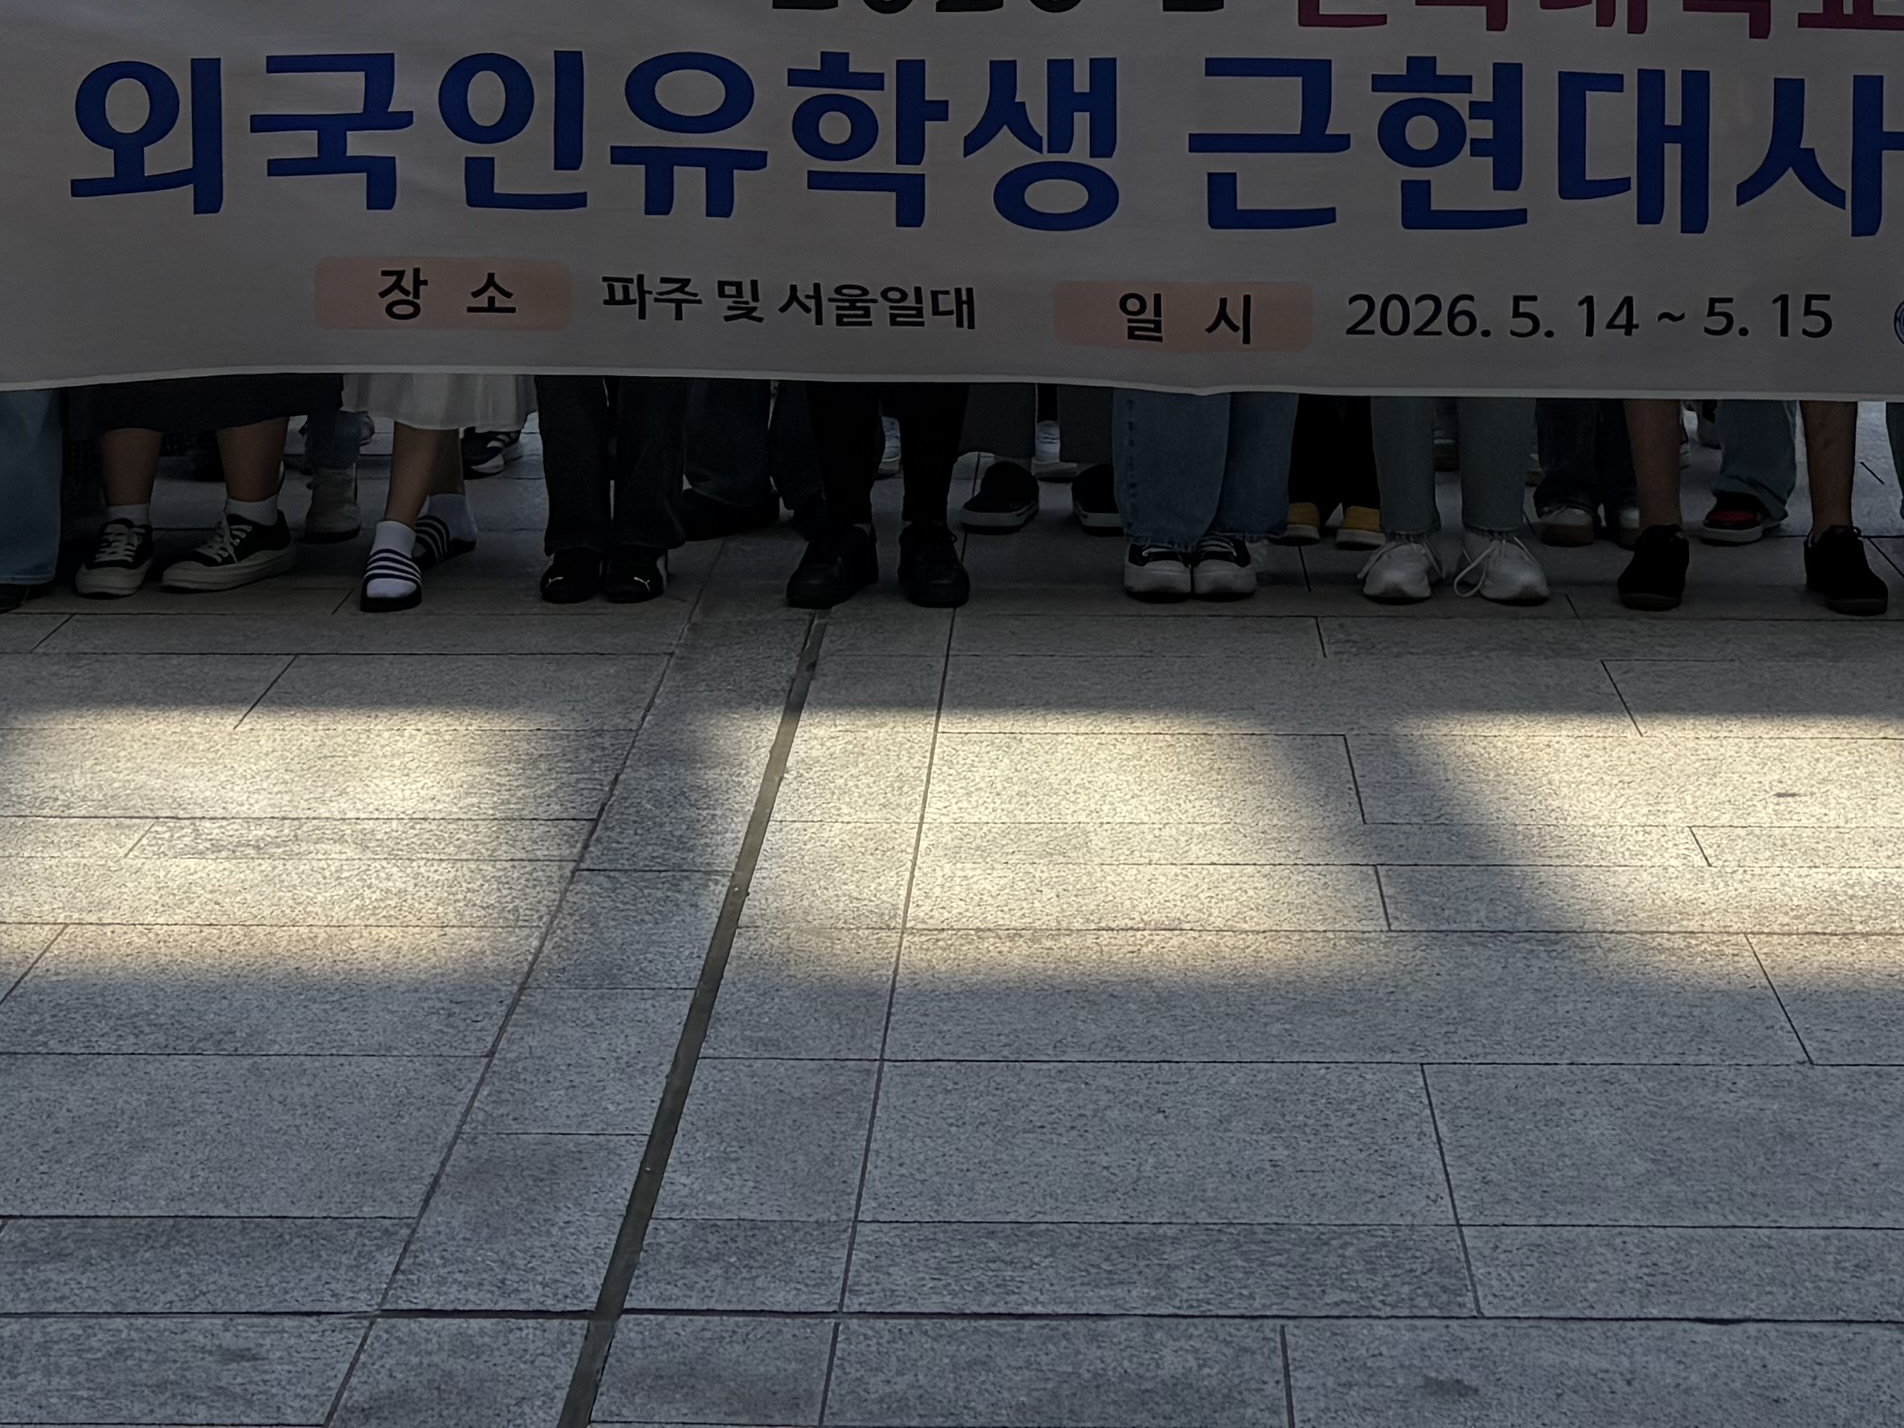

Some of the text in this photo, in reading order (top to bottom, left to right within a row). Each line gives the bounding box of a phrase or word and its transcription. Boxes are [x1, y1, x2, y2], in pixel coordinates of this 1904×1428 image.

[71, 50, 1119, 231] 외국인유학생
[602, 274, 702, 321] 파주
[717, 280, 764, 323] 및
[777, 283, 976, 329] 서울일대
